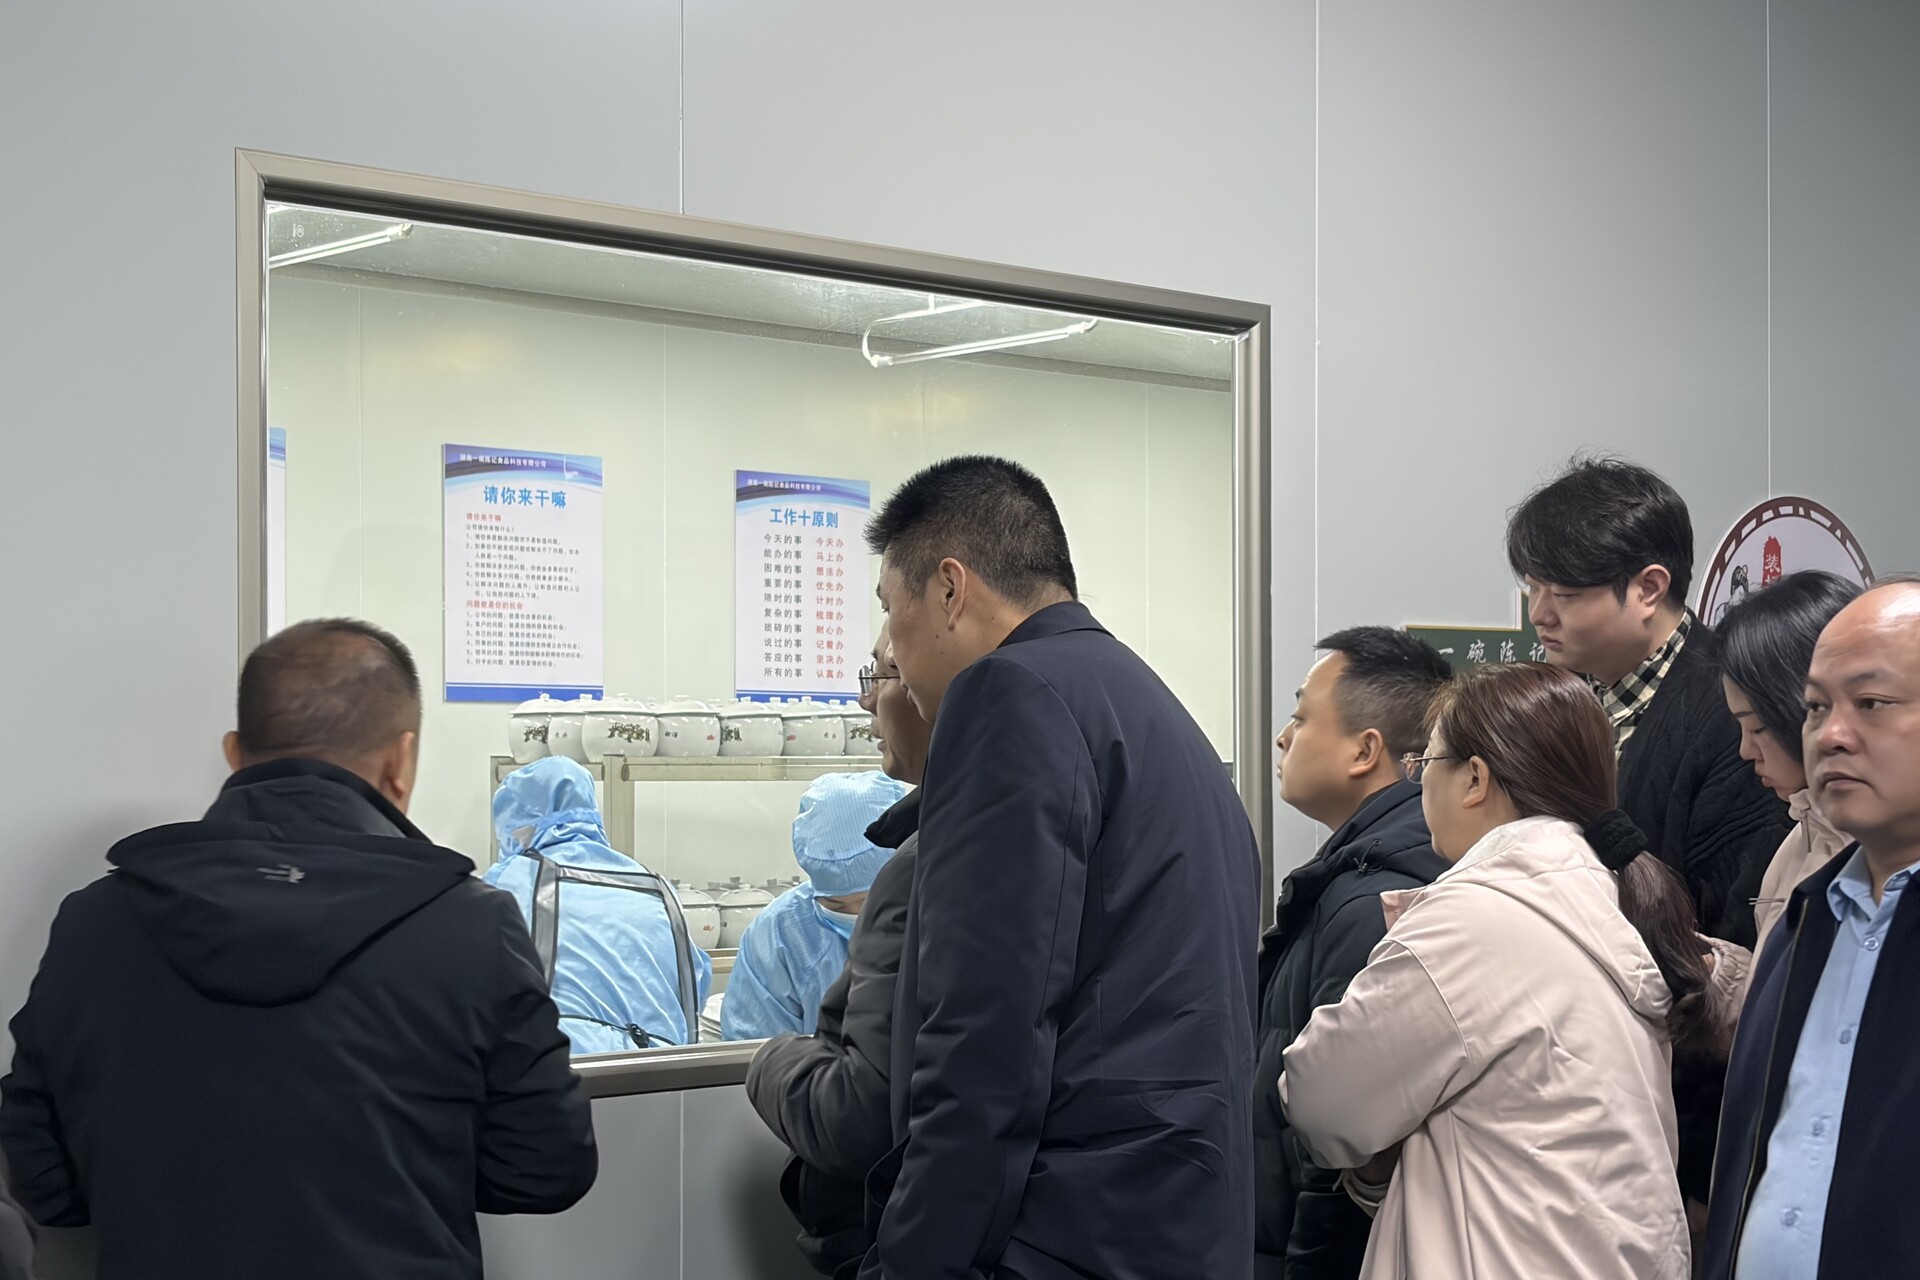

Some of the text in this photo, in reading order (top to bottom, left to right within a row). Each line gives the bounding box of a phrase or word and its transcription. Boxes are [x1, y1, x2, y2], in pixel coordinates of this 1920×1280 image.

[483, 485, 567, 509] 请你来干嘛
[466, 512, 502, 522] 请你来干嘛
[769, 507, 839, 529] 工作十原则
[763, 533, 844, 548] 今天的事 今天办
[763, 548, 844, 562] 能办的事 马上办
[763, 563, 844, 577] 困难的事 想法办
[763, 578, 844, 592] 重要的事 优先办
[816, 596, 844, 606] 计时办
[763, 607, 844, 621] 复杂的事 梳理办
[816, 625, 844, 635] 耐心办
[763, 637, 844, 650] 说过的事 记着办
[1438, 638, 1547, 664] 一碗陈记
[763, 652, 844, 665] 答应的事 坚决办
[763, 667, 844, 679] 所有的事 认真办
